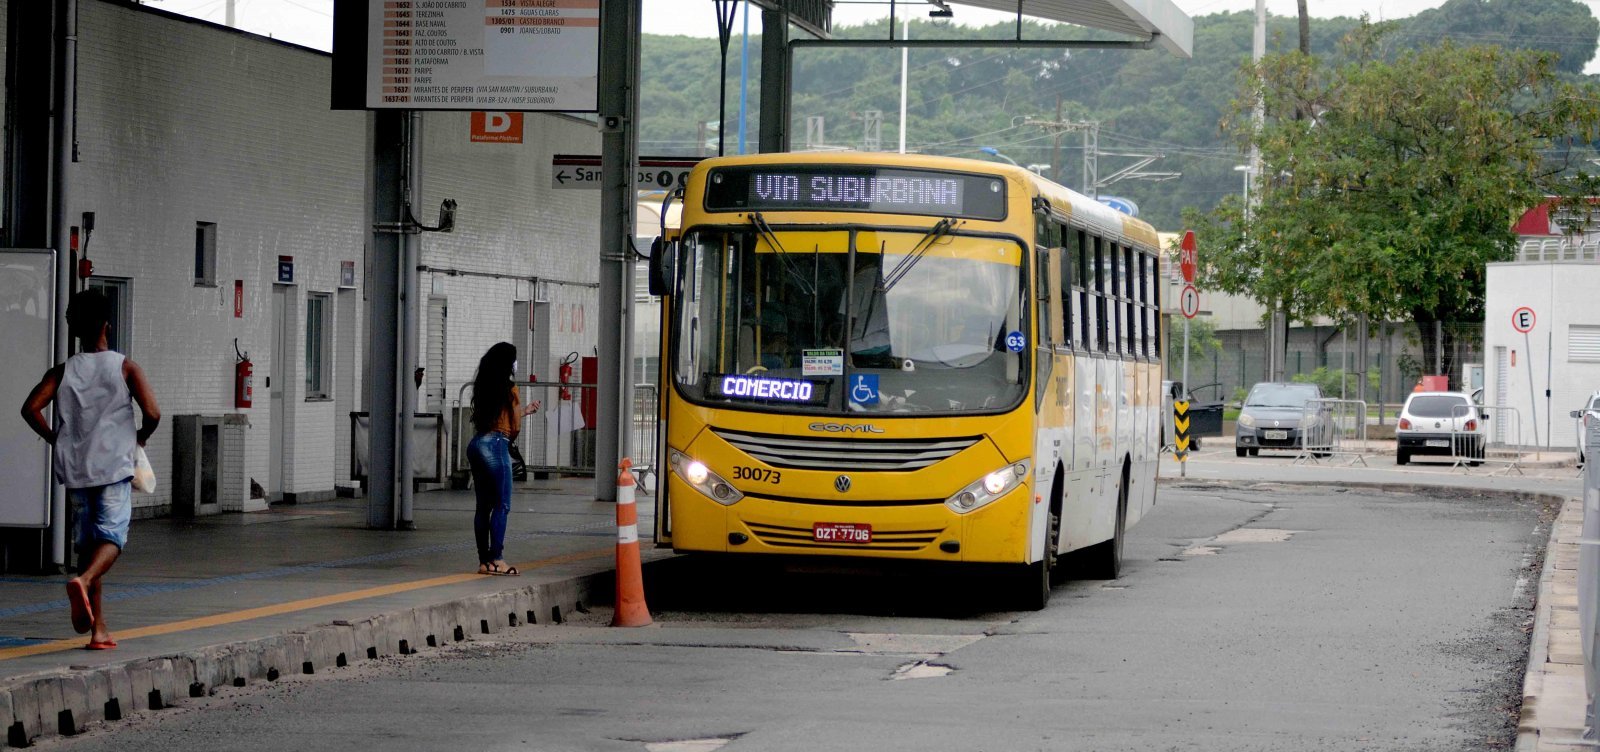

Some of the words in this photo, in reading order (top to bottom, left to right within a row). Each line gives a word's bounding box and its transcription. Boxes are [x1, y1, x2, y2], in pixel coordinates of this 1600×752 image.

[756, 174, 798, 200] VIA
[811, 176, 957, 205] SUBURBANA
[1519, 312, 1530, 327] E
[1007, 336, 1024, 346] G3
[723, 377, 812, 400] COMERCIO
[733, 466, 781, 484] 30073
